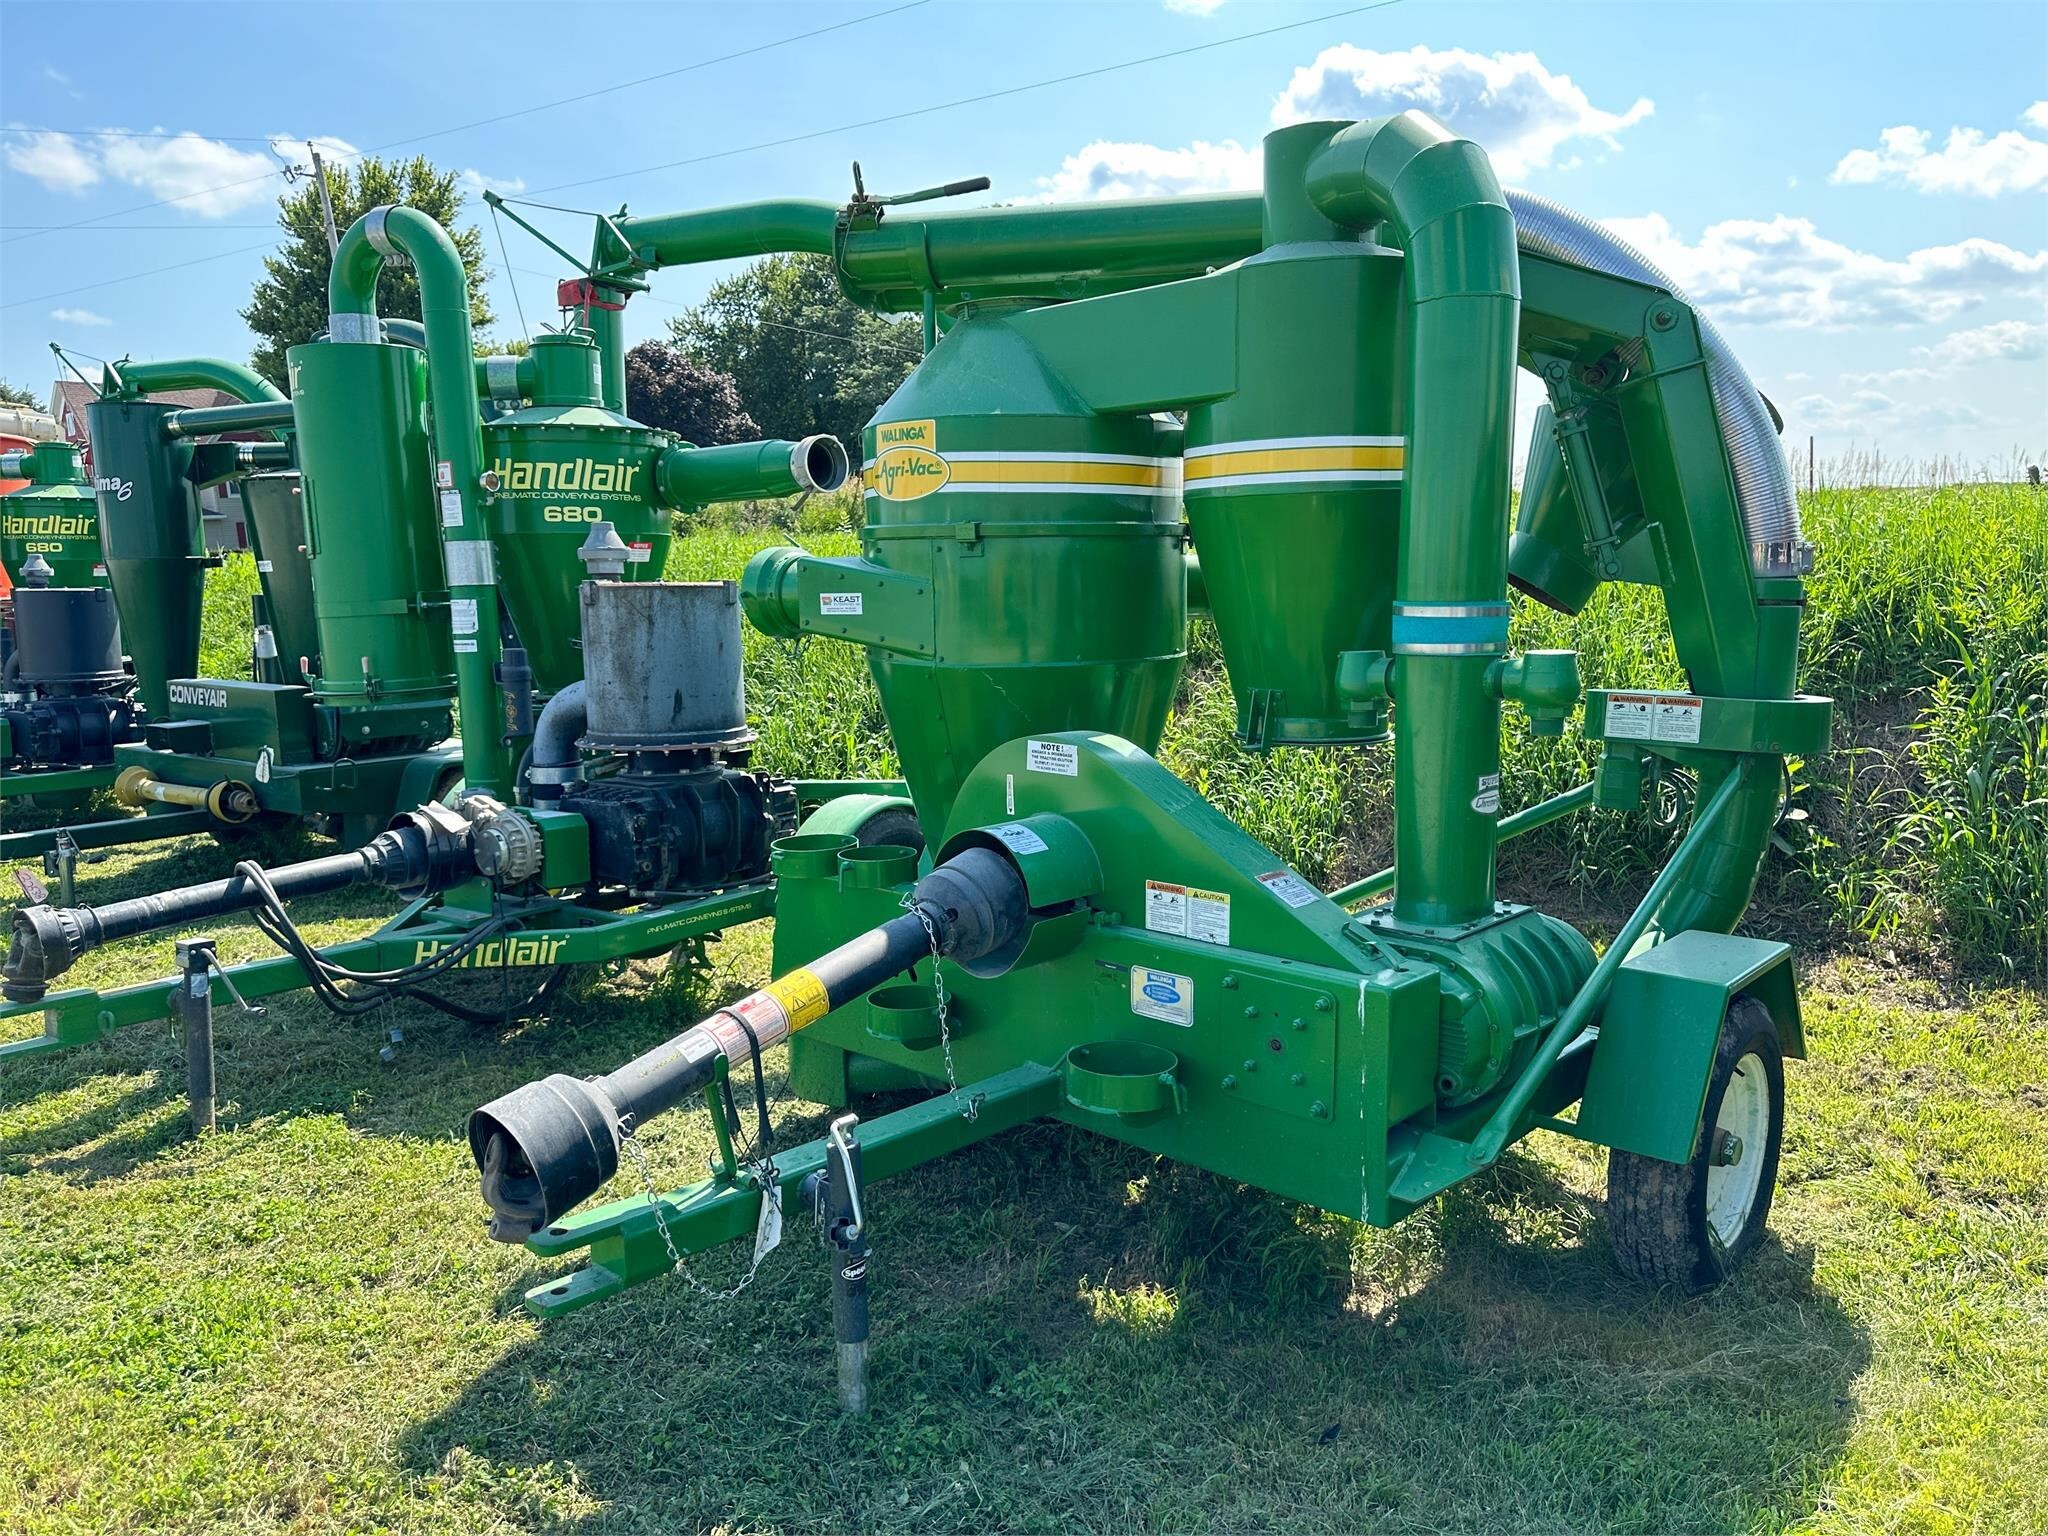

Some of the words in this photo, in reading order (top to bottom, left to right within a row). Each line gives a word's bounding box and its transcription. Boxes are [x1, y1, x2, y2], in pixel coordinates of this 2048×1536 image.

[494, 457, 640, 492] Handlair
[494, 491, 540, 499] PNEUMATIC
[541, 491, 600, 500] CONVEYING
[601, 493, 642, 502] SYSTEMS
[543, 505, 603, 523] 680
[2, 514, 94, 535] Handlair
[25, 542, 63, 552] 680
[833, 595, 860, 603] KEAST
[169, 685, 227, 708] CONVEYAIR
[1199, 892, 1225, 902] CAUTION
